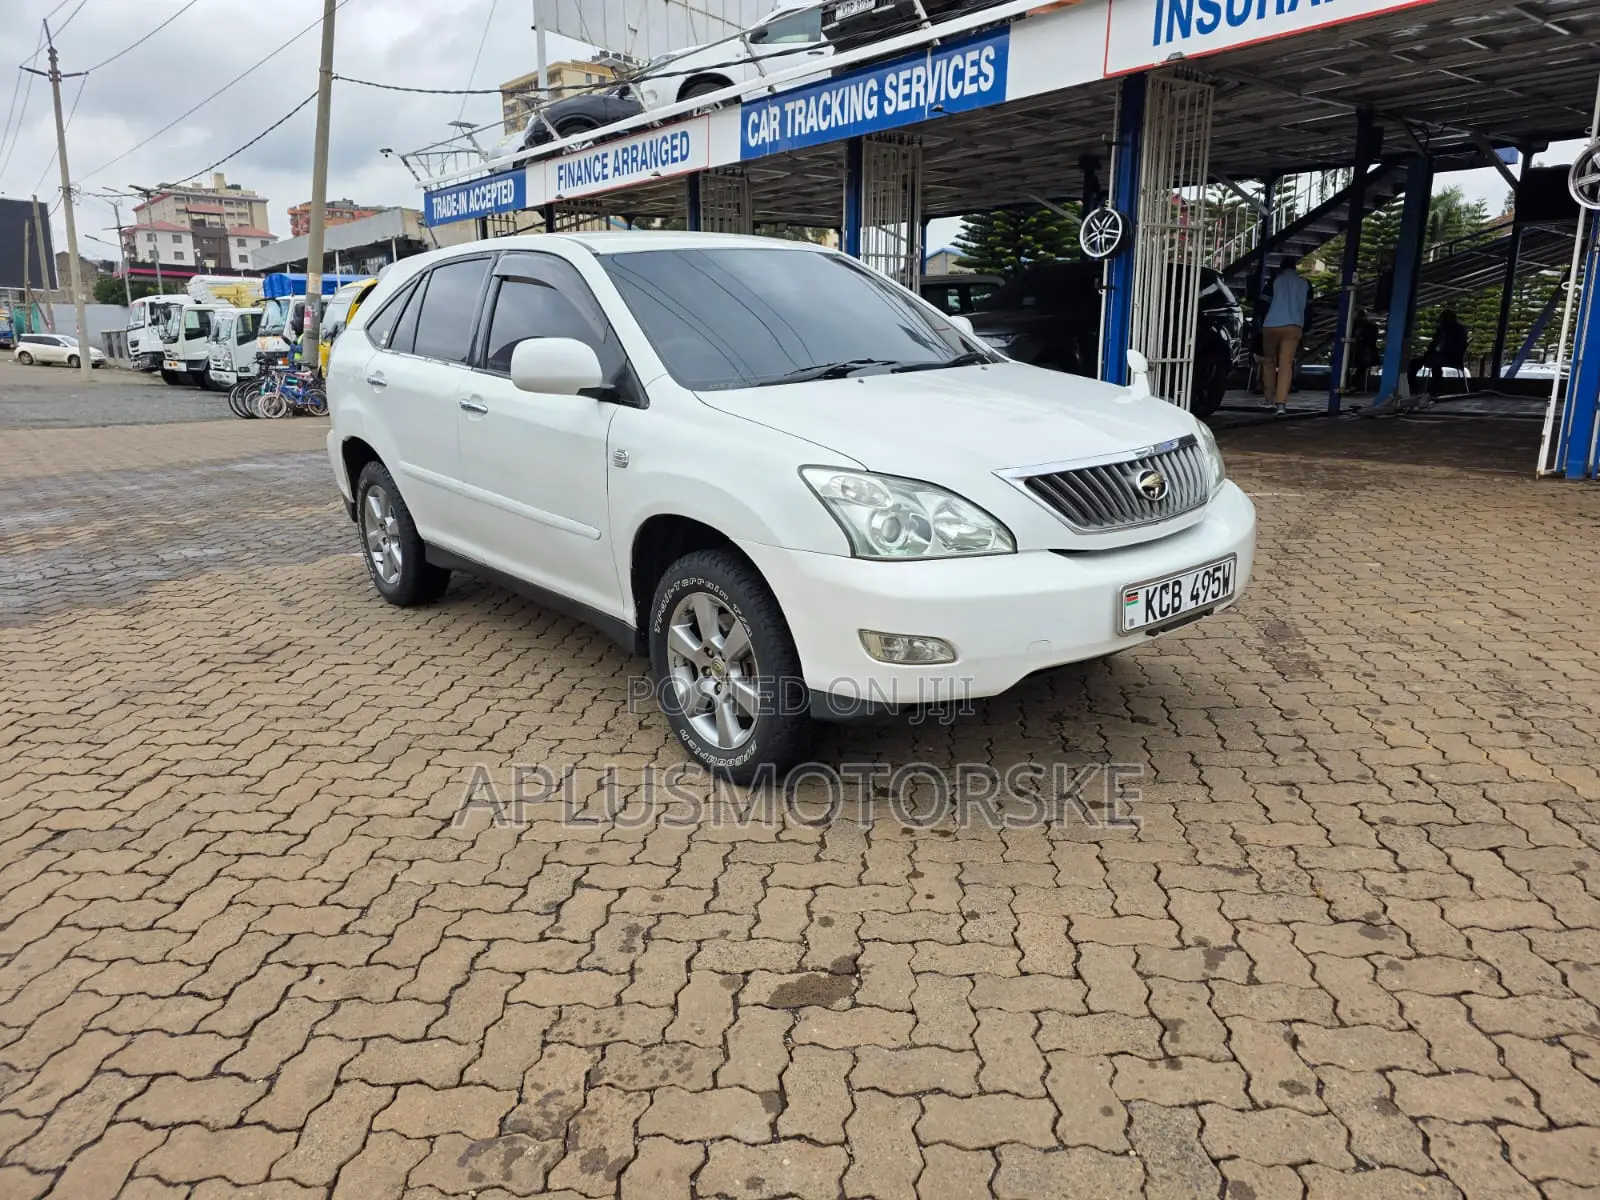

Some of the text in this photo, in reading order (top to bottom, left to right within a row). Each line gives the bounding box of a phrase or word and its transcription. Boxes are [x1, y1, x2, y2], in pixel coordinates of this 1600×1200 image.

[747, 45, 996, 148] CAR TRACKING SERVICES
[556, 130, 690, 192] FINANCE ARRANGED
[432, 178, 515, 219] TRADE-IN ACCEPTED
[1145, 562, 1232, 623] KCB 495W
